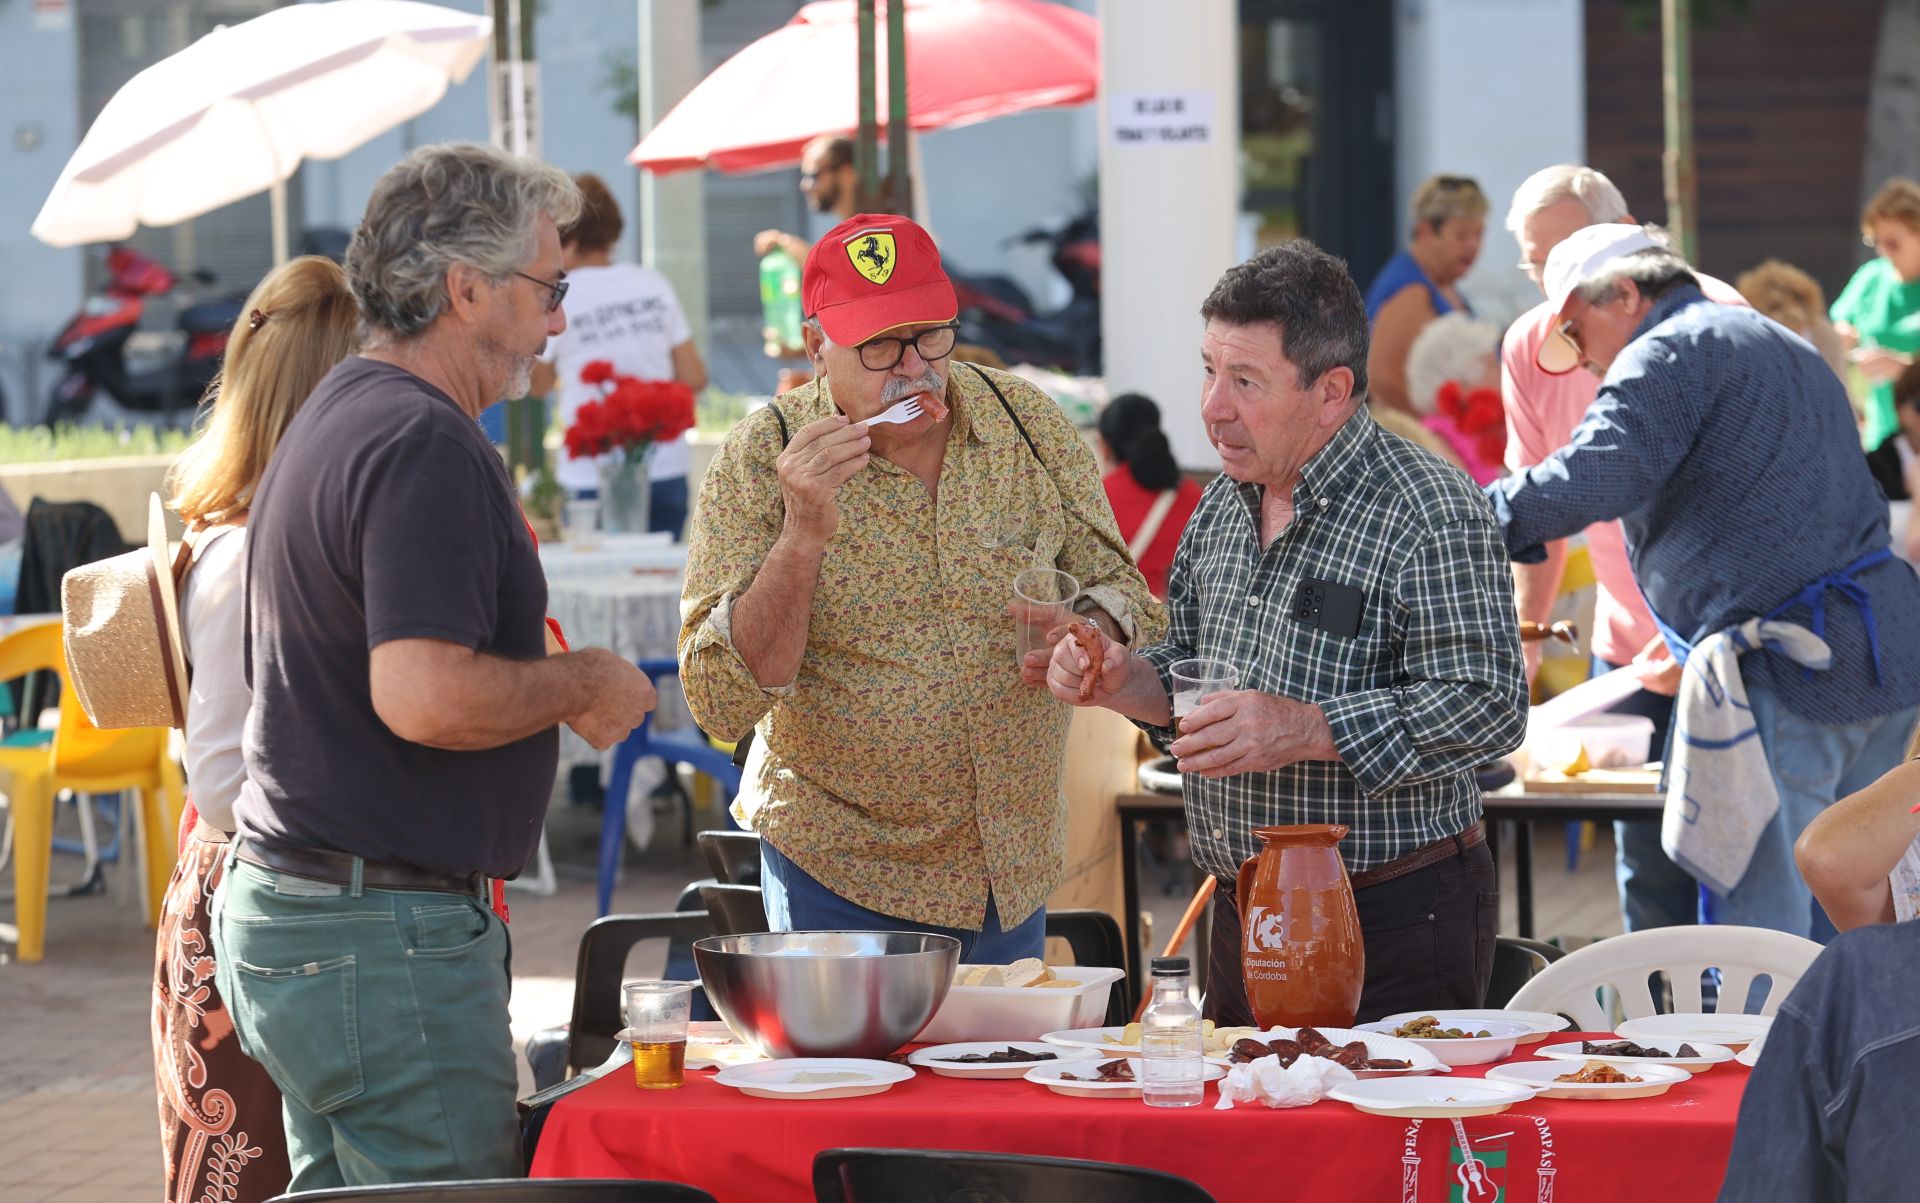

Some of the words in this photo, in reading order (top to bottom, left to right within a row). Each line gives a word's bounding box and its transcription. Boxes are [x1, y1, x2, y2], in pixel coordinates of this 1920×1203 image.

[1246, 957, 1286, 969] Diputación
[1404, 1119, 1424, 1156] PEÑA
[1532, 1116, 1556, 1168] OMPÁS
